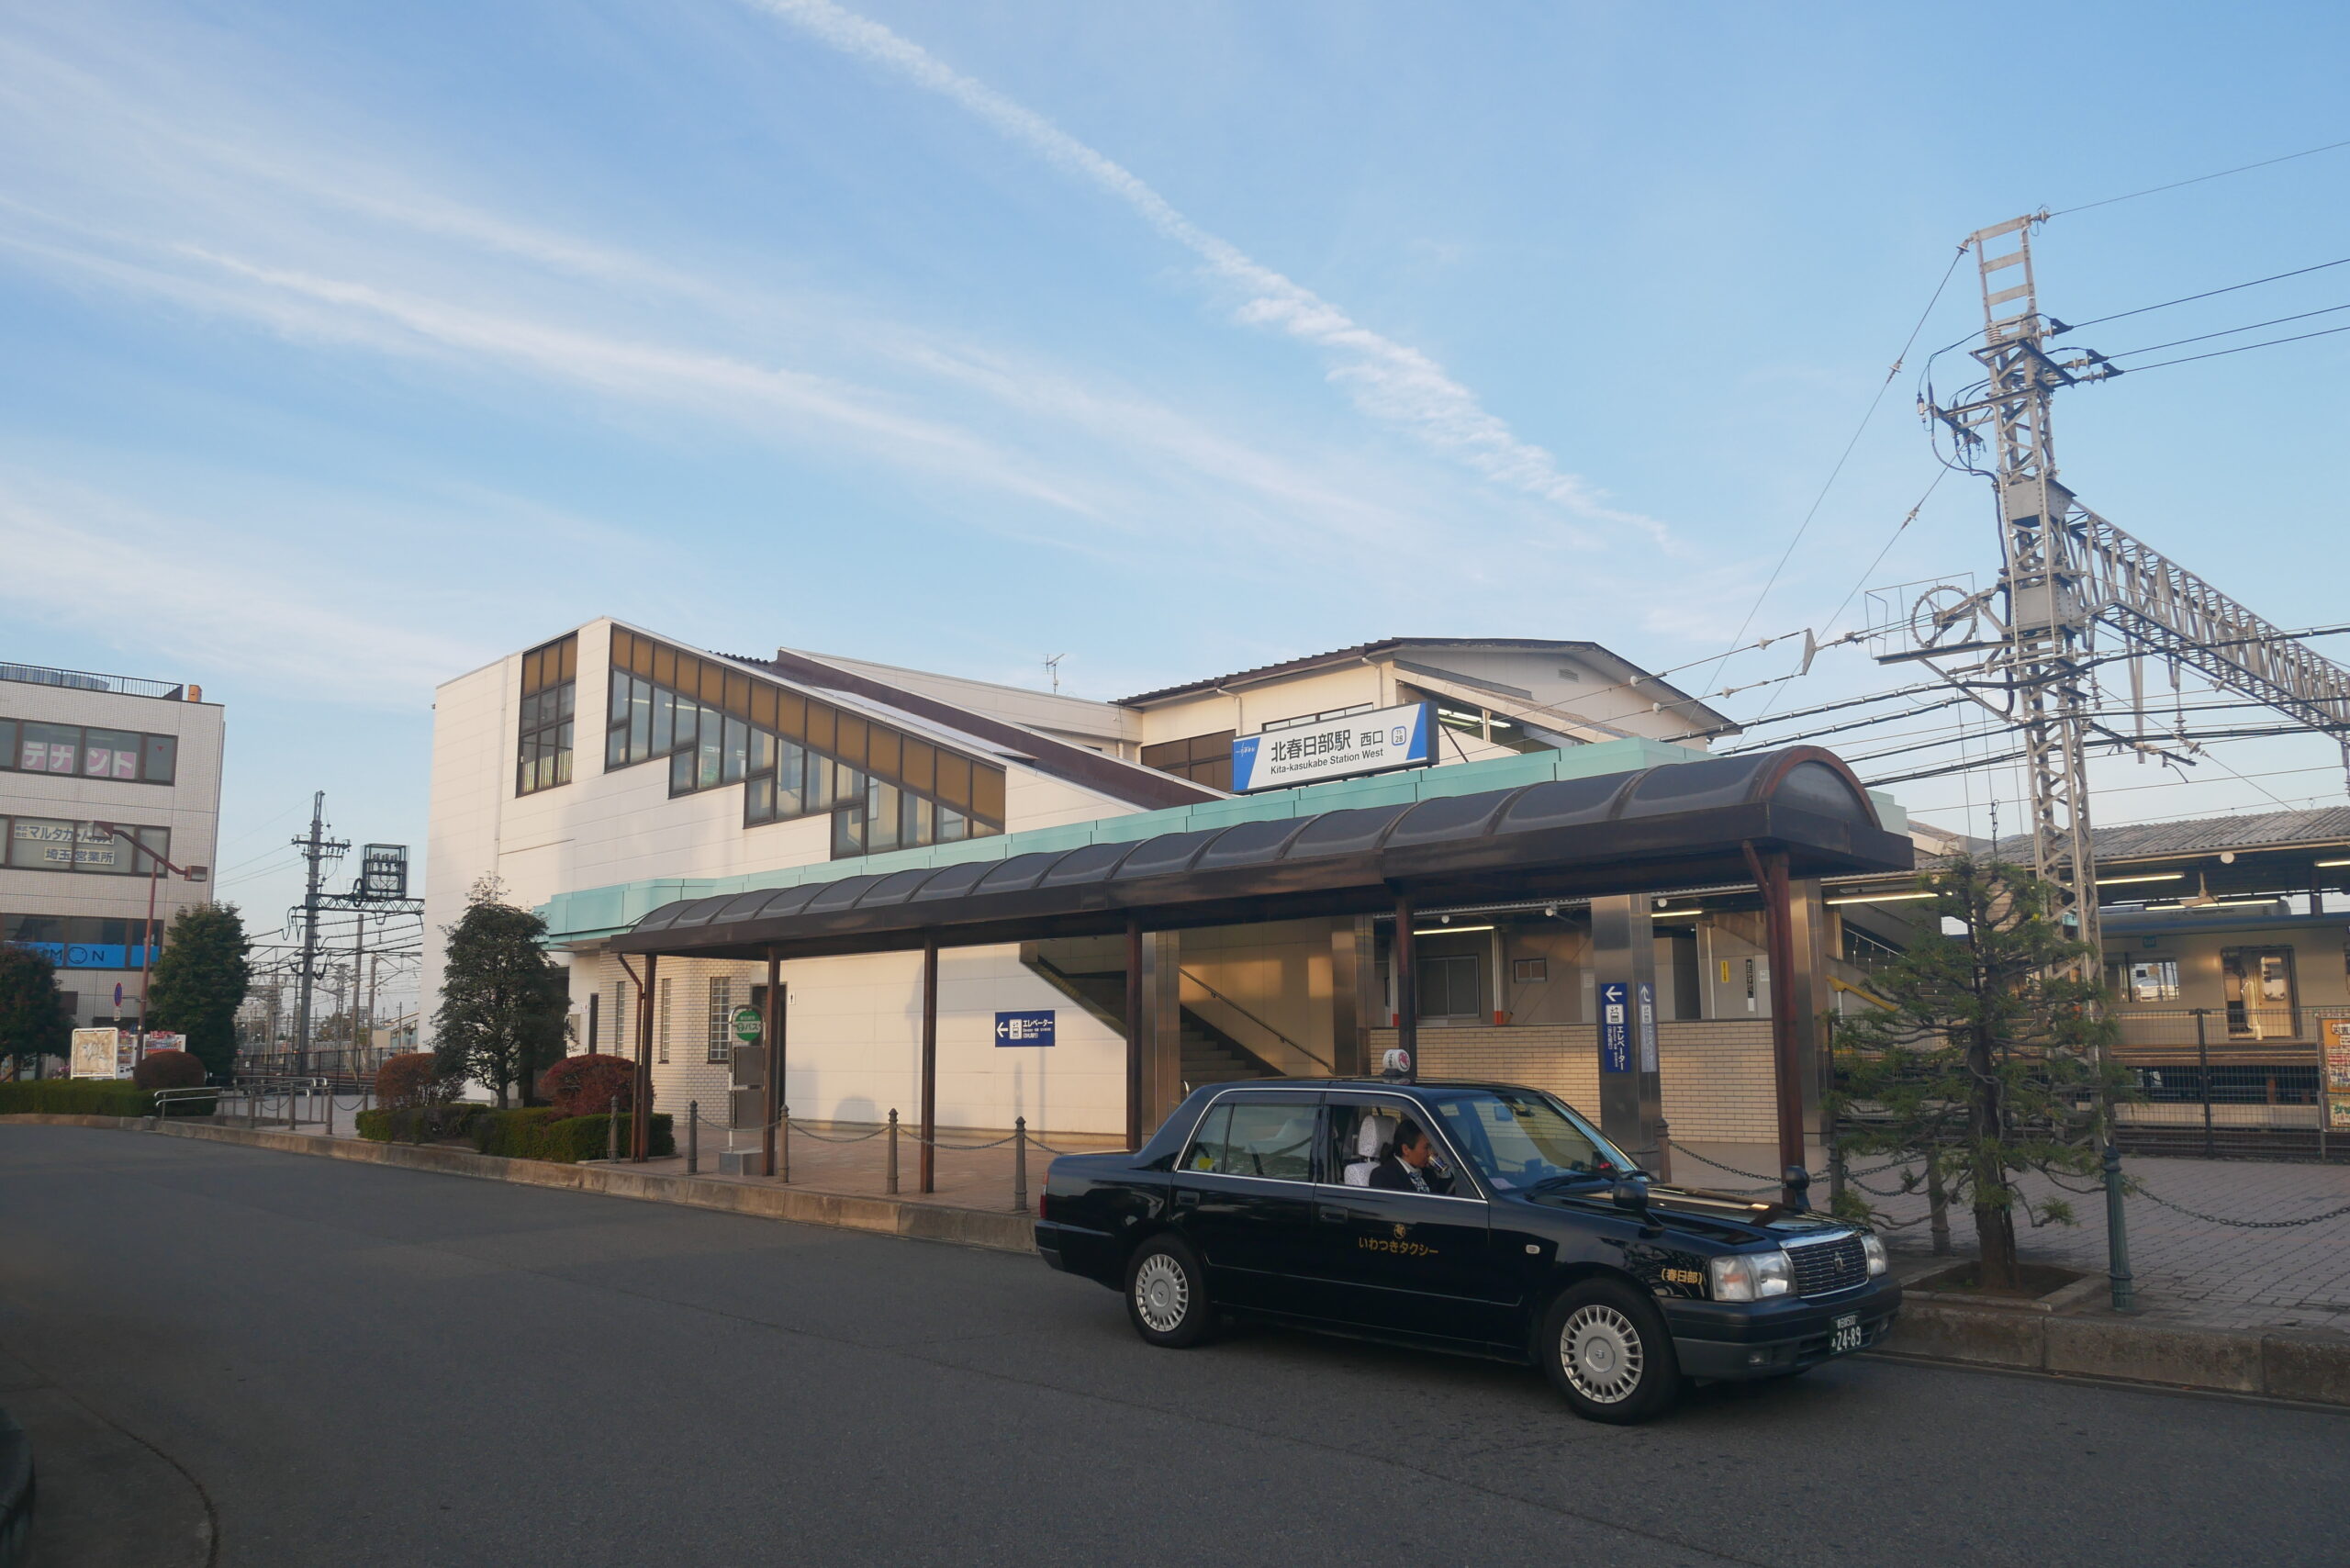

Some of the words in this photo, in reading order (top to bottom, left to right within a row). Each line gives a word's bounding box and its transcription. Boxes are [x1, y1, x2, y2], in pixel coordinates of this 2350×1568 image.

[1270, 729, 1351, 762] 北春日部駅
[1360, 730, 1384, 747] 西口
[1394, 734, 1404, 743] 28
[24, 743, 133, 777] テナント
[1270, 758, 1328, 775] Kita-kasukabe
[1330, 753, 1360, 765] Station
[1361, 747, 1384, 759] West
[45, 847, 114, 864] 埼玉営業所
[1022, 1018, 1054, 1027] エレベーター
[1617, 1025, 1625, 1070] エレベーター
[1359, 1236, 1439, 1257] いわつきタクシー
